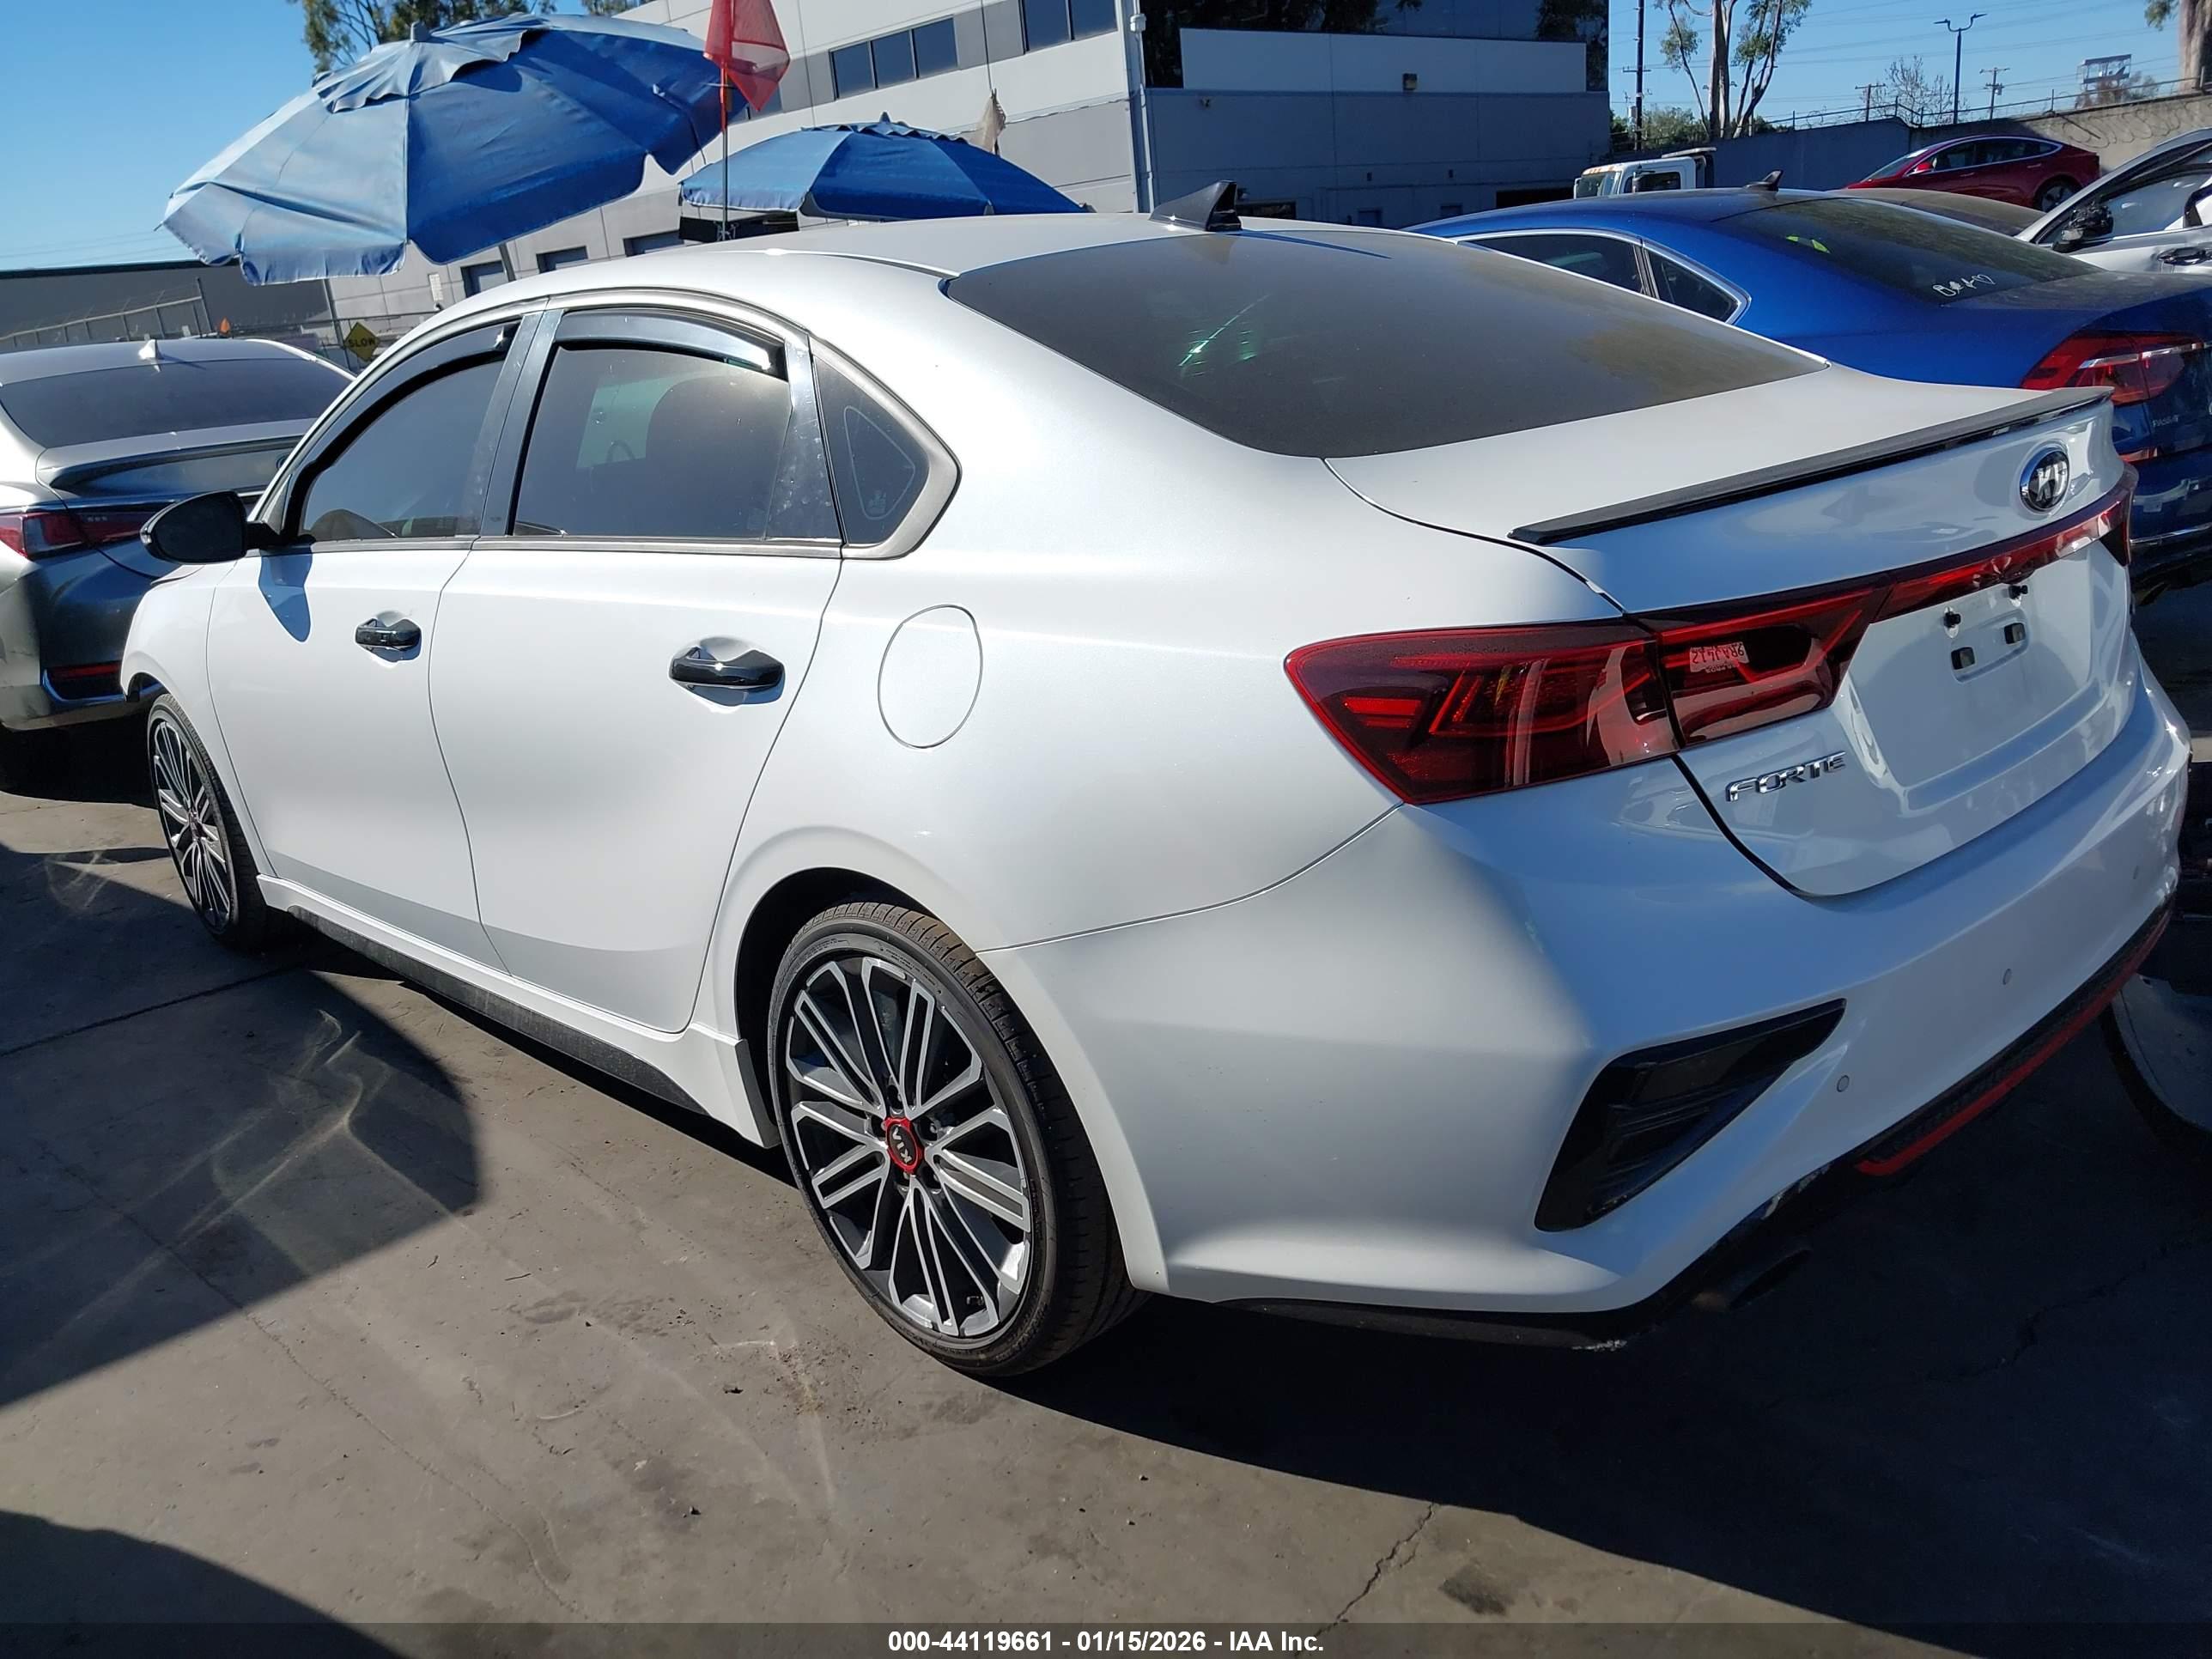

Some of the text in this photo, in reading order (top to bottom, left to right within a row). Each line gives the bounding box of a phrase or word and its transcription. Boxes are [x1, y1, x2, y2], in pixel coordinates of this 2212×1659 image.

[348, 337, 376, 348] SLOW
[1724, 750, 1846, 802] FORTE
[892, 1126, 913, 1164] KIA
